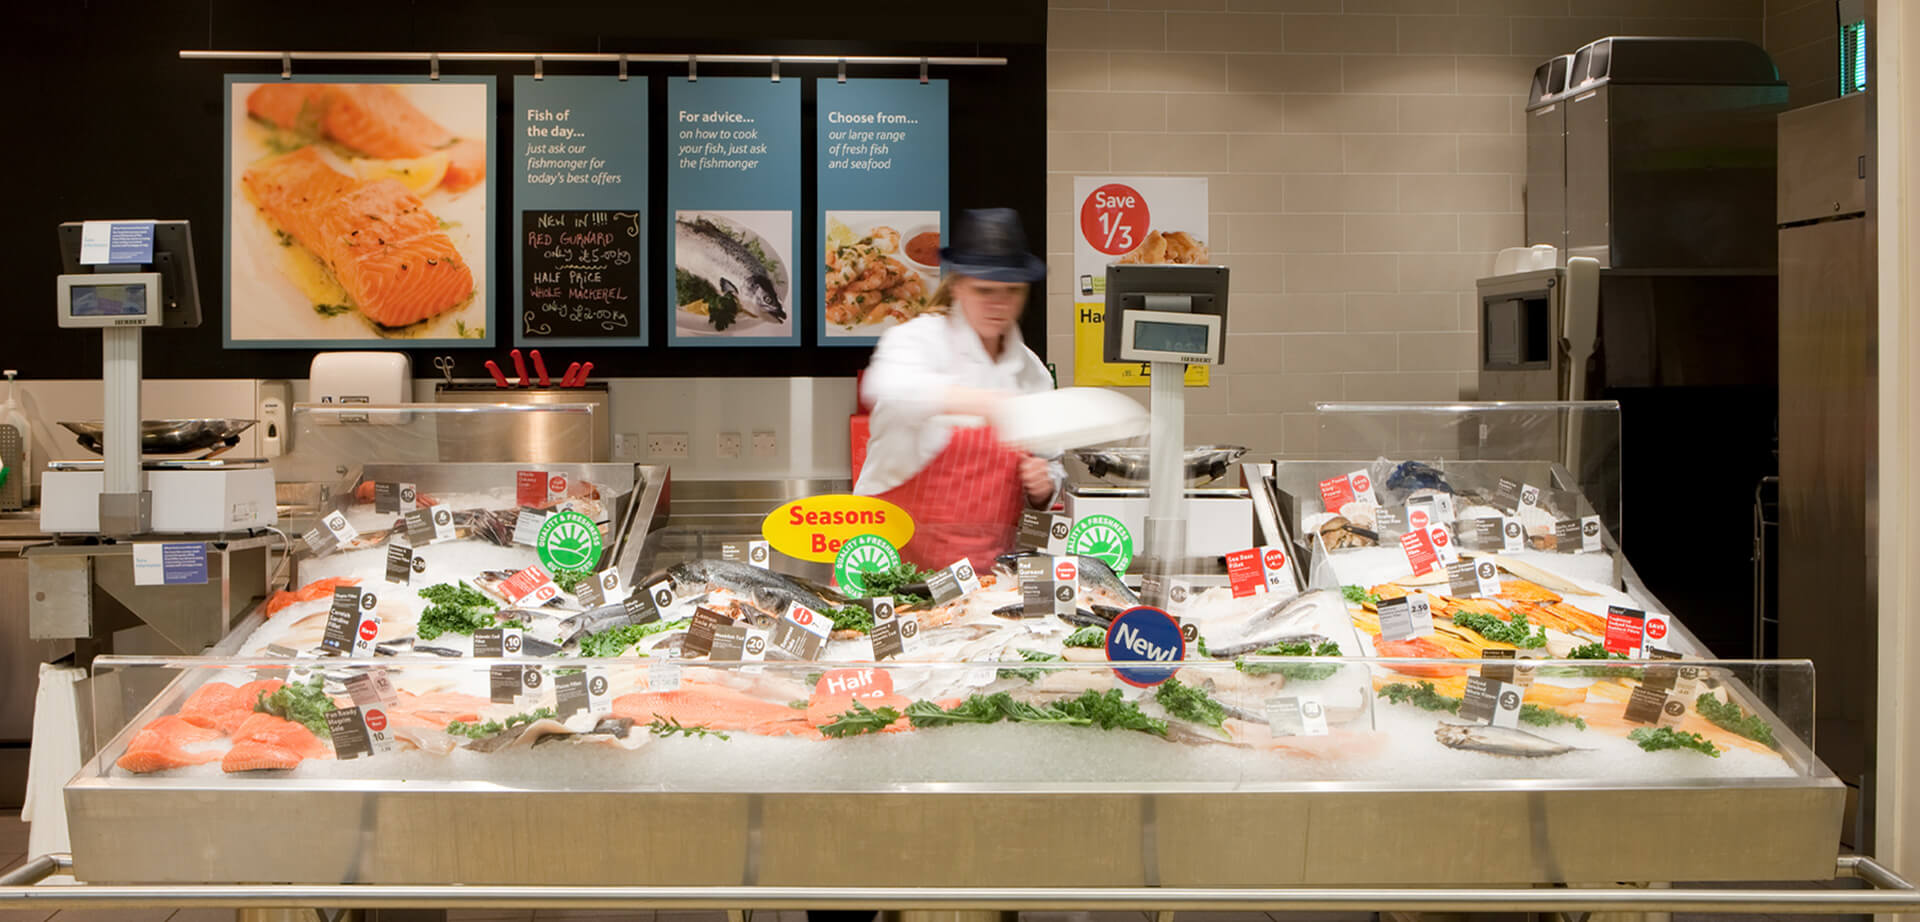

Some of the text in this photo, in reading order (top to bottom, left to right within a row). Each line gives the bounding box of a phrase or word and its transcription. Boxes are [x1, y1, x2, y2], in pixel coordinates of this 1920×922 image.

[527, 109, 570, 121] Fish of
[679, 110, 755, 122] For advice...
[828, 112, 919, 124] Choose from...
[527, 125, 585, 140] the day...
[679, 128, 758, 139] on how to cook
[828, 129, 906, 142] our large range
[525, 143, 586, 155] just ask our
[678, 143, 767, 156] your fish, just ask
[828, 143, 889, 156] of fresh fish
[527, 157, 606, 171] fishmonger for
[679, 157, 759, 171] the fishmonger
[828, 158, 892, 171] and seafood
[527, 172, 621, 185] today's best offers
[1095, 191, 1135, 208] Save
[538, 213, 565, 228] NEW
[1098, 212, 1133, 249] 1/3
[528, 231, 614, 249] RED GURNARD
[534, 272, 561, 284] HALF
[530, 287, 628, 304] WHOLE MACKEREL
[1080, 309, 1105, 323] Ha
[789, 505, 886, 526] Seasons
[539, 517, 559, 547] QUALITY
[566, 514, 601, 546] FRESHNESS
[812, 533, 849, 553] Be
[836, 540, 858, 568] QUALITY
[1411, 603, 1428, 613] 2.50
[356, 640, 368, 650] 40
[1114, 622, 1178, 662] New!
[827, 669, 874, 694] Half
